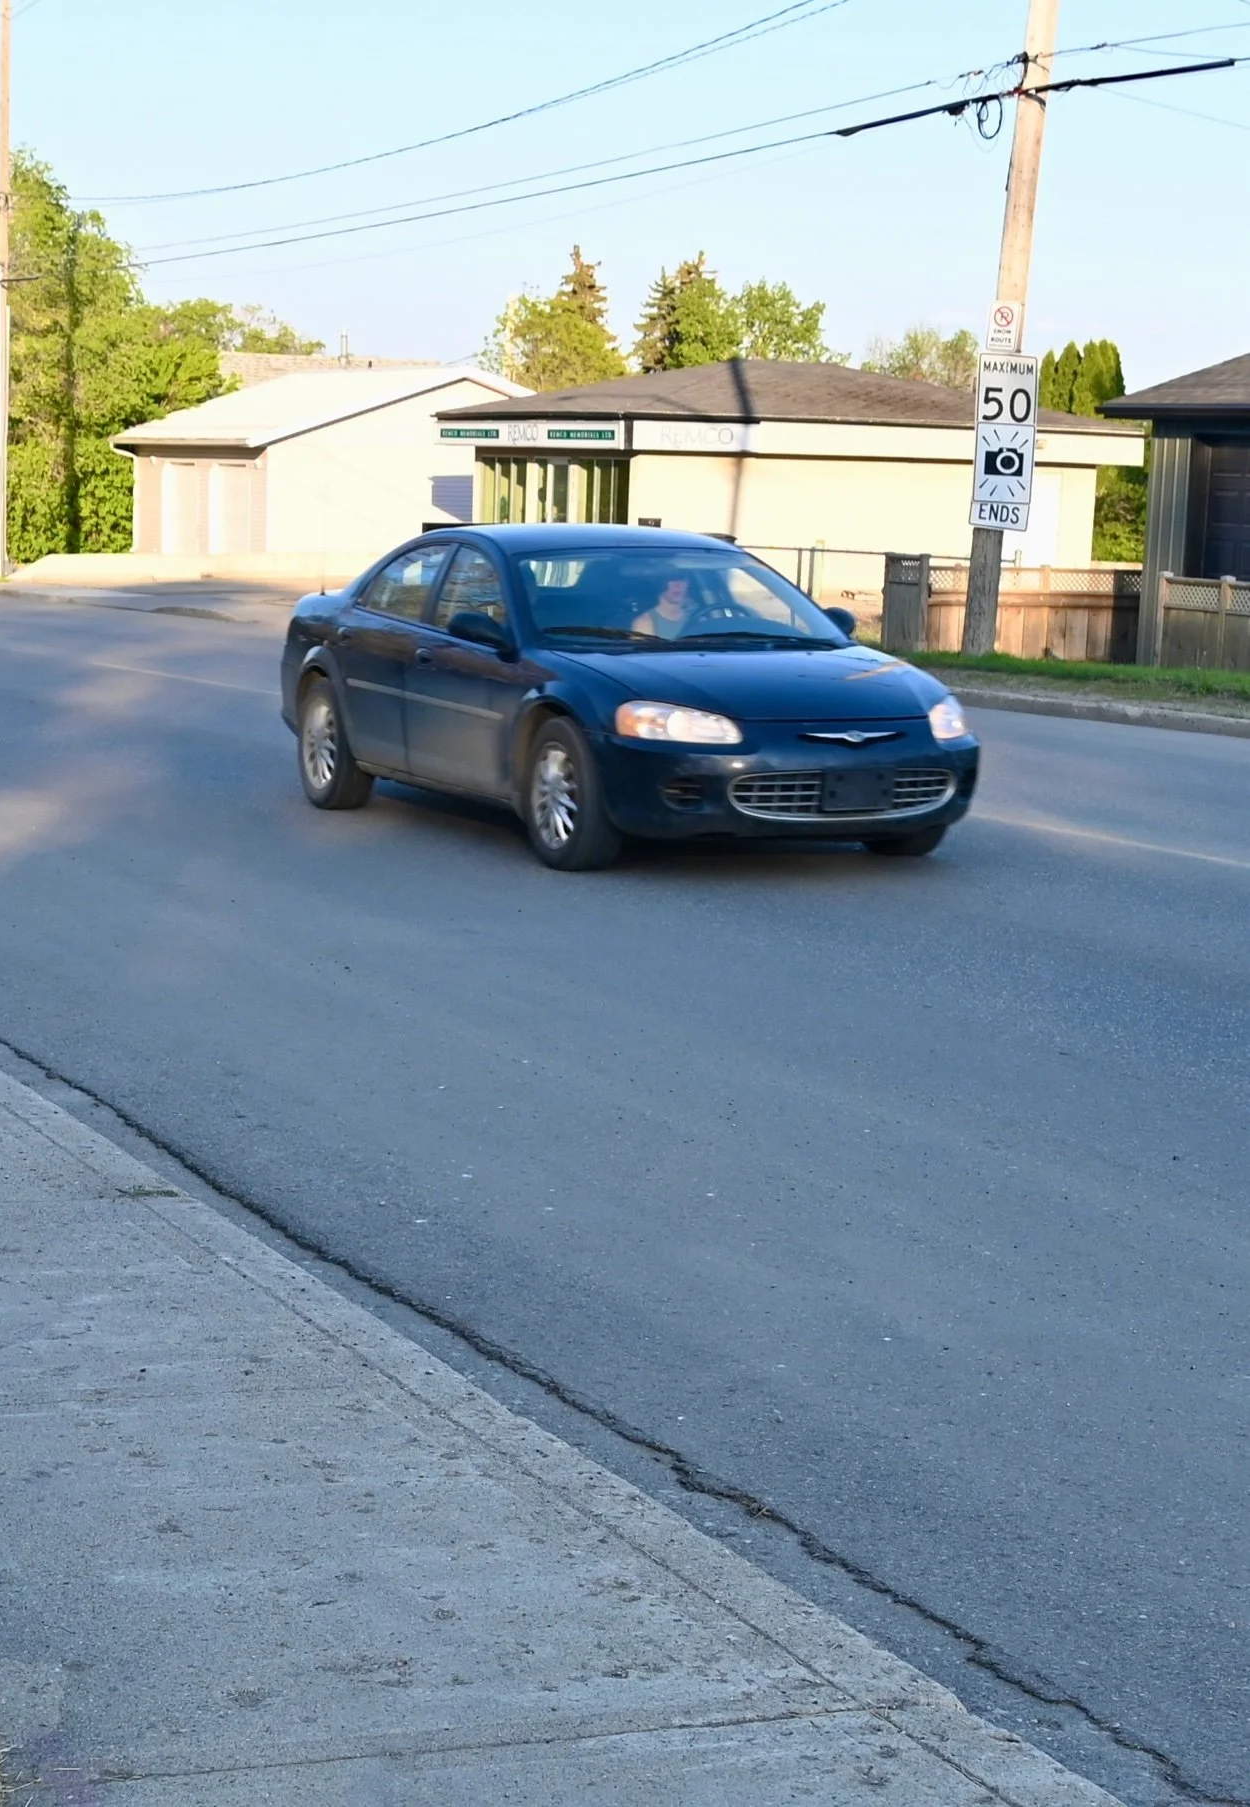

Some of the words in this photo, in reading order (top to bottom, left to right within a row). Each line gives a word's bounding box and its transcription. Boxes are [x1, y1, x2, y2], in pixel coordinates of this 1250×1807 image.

[990, 336, 1012, 344] ROUTE
[983, 360, 1034, 376] MAXIMUM
[982, 387, 1031, 423] 50
[507, 424, 539, 445] REMCO
[659, 426, 734, 448] REMCO
[978, 503, 1020, 525] ENDS
